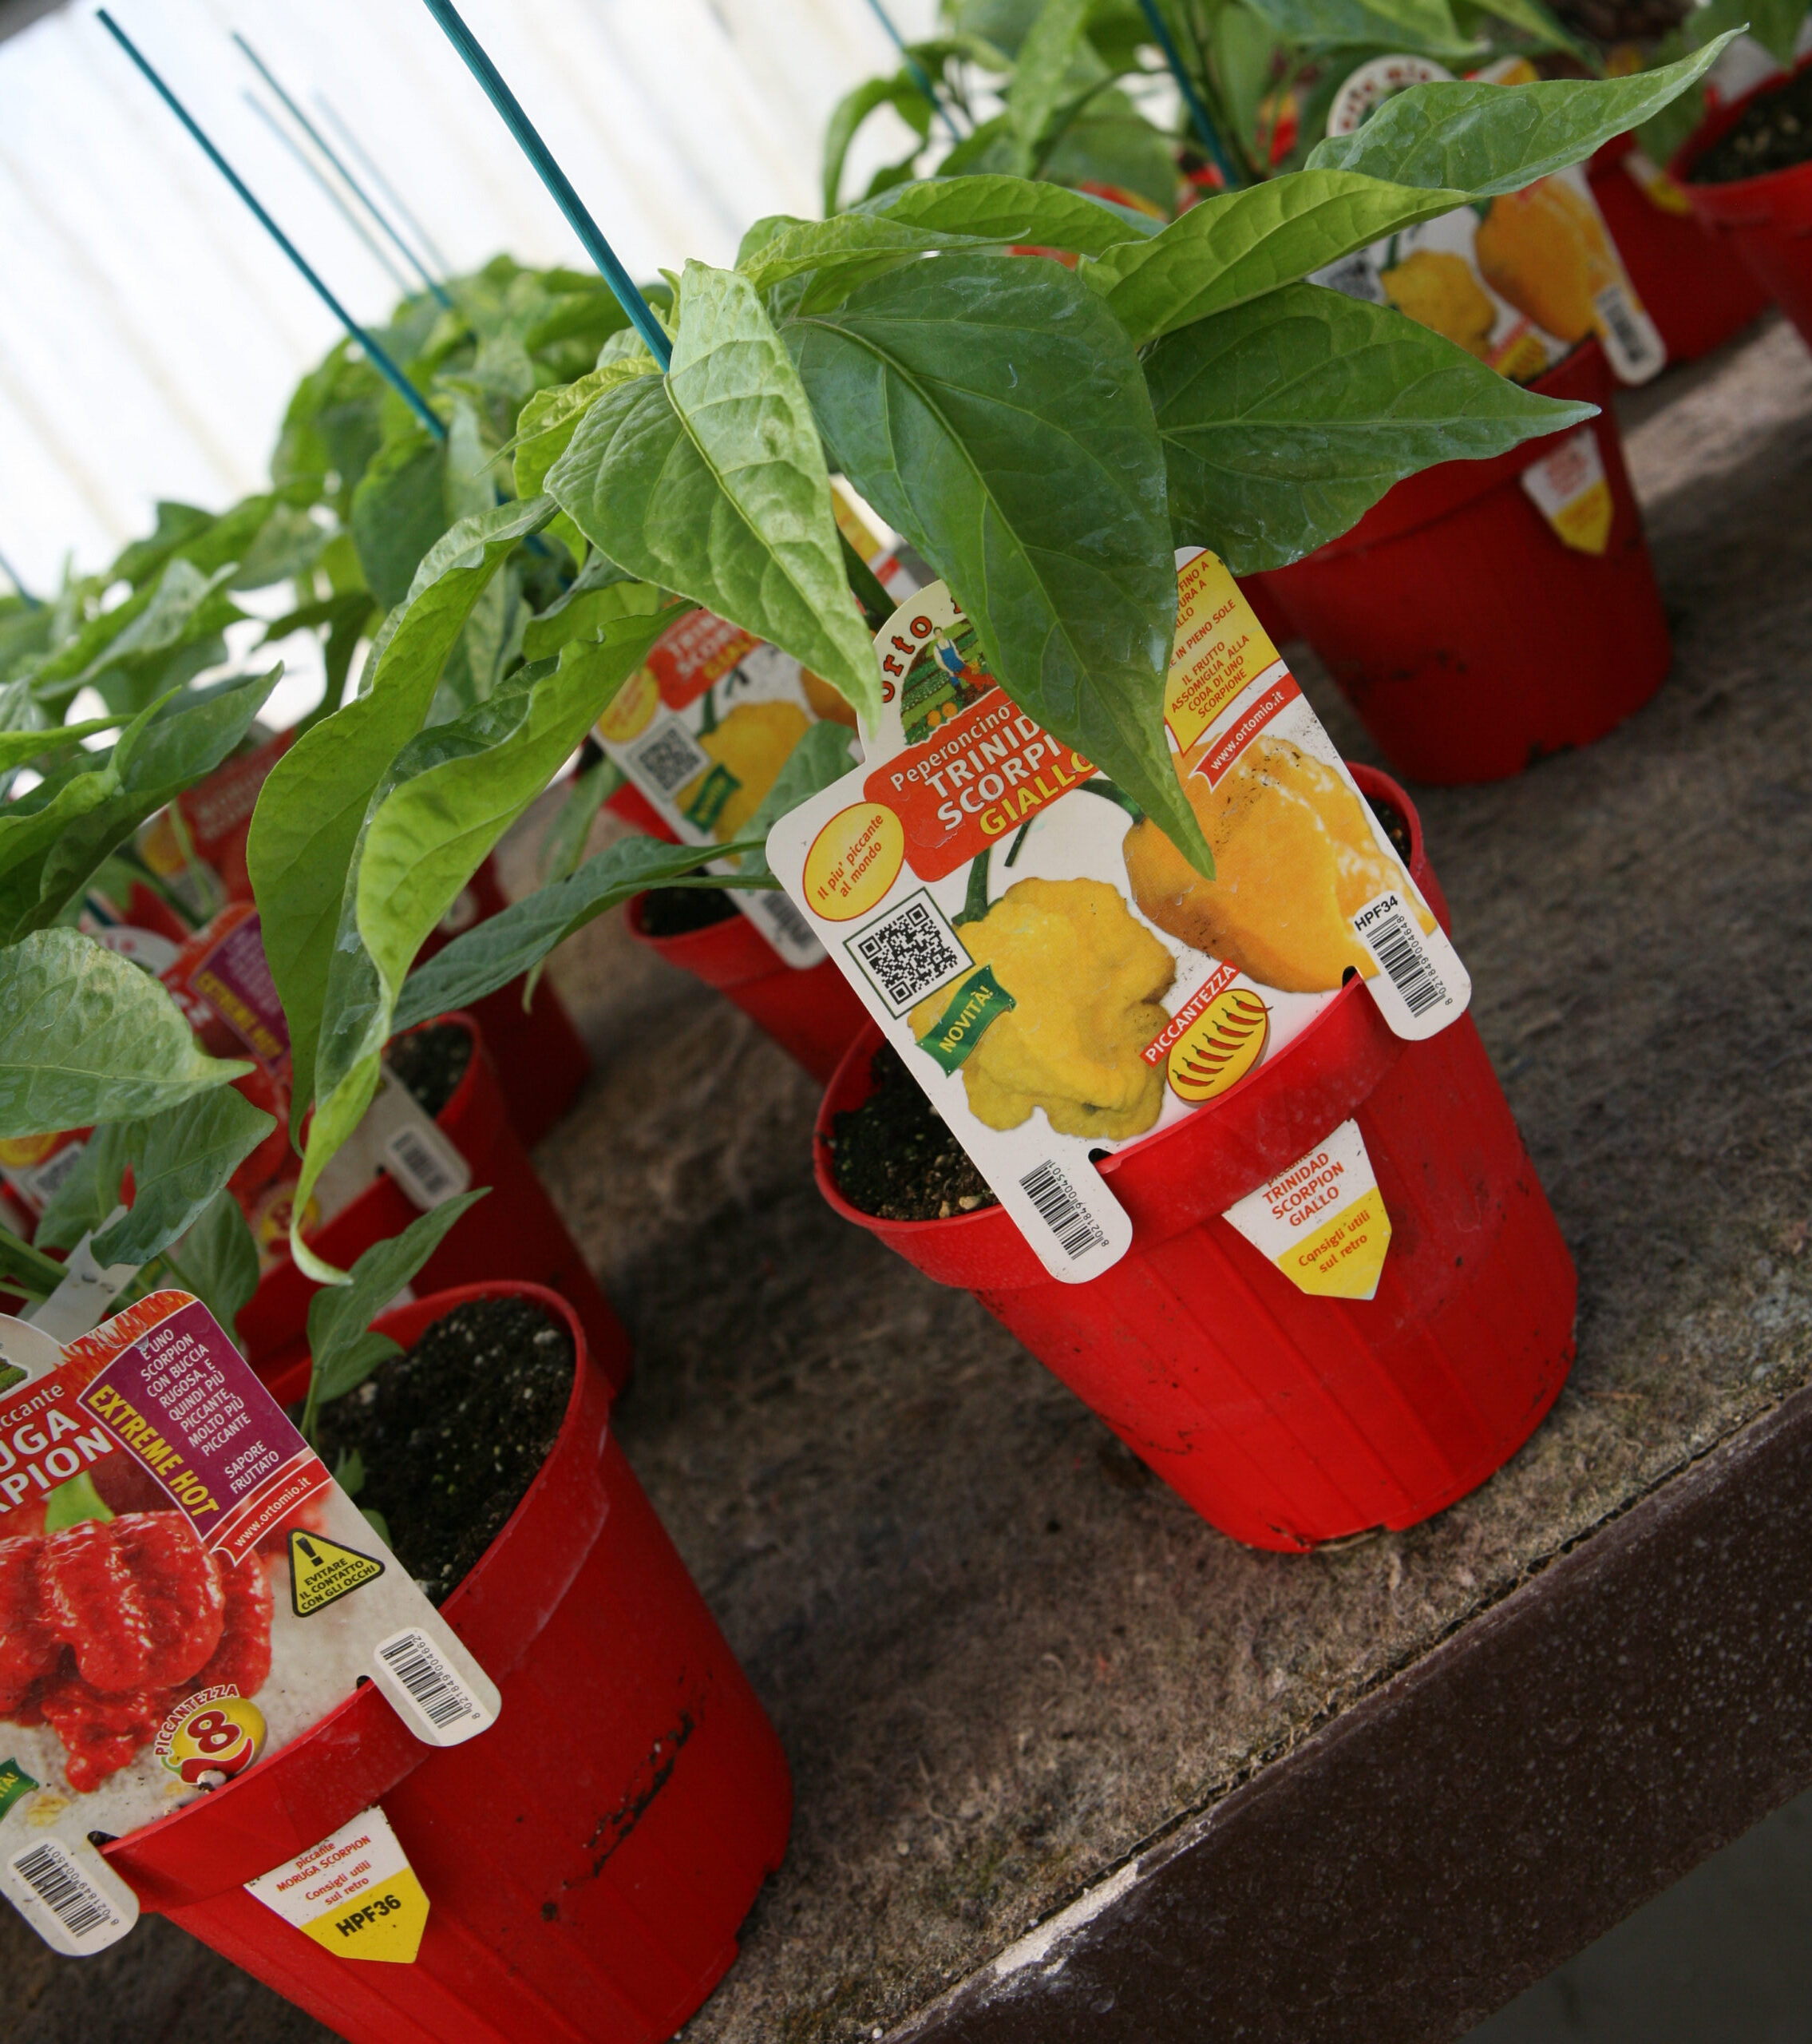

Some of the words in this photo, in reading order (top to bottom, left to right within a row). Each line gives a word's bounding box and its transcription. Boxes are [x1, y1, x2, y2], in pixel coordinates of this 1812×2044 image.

[1178, 568, 1200, 592] FINO
[1201, 560, 1209, 572] A
[1198, 579, 1207, 590] A
[1176, 645, 1187, 660] IN
[1186, 621, 1213, 649] PIENO
[1212, 599, 1236, 624] SOLE
[1171, 660, 1224, 713] ASSOMIGLIA
[1227, 635, 1250, 658] ALLA
[1181, 673, 1193, 686] IL
[1192, 641, 1225, 674] FRUTTO
[1188, 687, 1213, 712] CODA
[1213, 676, 1224, 689] DI
[1224, 655, 1244, 677] UNO
[1197, 668, 1248, 719] SCORPIONE
[890, 706, 1011, 792] Peperoncino
[1211, 691, 1284, 771] www.ortomio.it
[846, 814, 884, 866] piccante
[840, 881, 852, 897] al
[851, 842, 882, 884] mondo
[1354, 895, 1398, 931] HPF34
[939, 984, 994, 1054] NOVITÀ!
[1145, 965, 1237, 1062] PICCANTEZZA
[1262, 1152, 1329, 1205] TRINIDAD
[1272, 1162, 1344, 1220] SCORPION
[1289, 1186, 1339, 1226] GIALLO
[1298, 1228, 1345, 1266] Consigli
[1347, 1210, 1371, 1232] utili
[1319, 1254, 1339, 1274] sul
[1339, 1234, 1368, 1258] retro
[141, 1333, 194, 1381] SCORPION
[149, 1329, 174, 1353] UNO
[146, 1376, 171, 1397] CON
[170, 1343, 209, 1379] BUCCIA
[159, 1373, 208, 1408] RUGOSA,
[206, 1358, 216, 1371] E
[168, 1386, 206, 1421] QUINDI
[204, 1369, 225, 1392] PIÙ
[0, 1384, 65, 1432] ccante
[180, 1388, 236, 1432] PICCANTE,
[188, 1414, 224, 1447] MOLTO
[224, 1396, 245, 1418] PIÙ
[88, 1384, 184, 1476] EXTREME
[168, 1470, 220, 1516] HOT
[201, 1412, 251, 1456] PICCANTE
[0, 1426, 114, 1513] PION
[224, 1440, 267, 1479] SAPORE
[230, 1451, 279, 1495] FRUTTATO
[234, 1477, 311, 1547] www.ortomio.it
[299, 1591, 311, 1600] IL
[311, 1560, 364, 1593] CONTATTO
[301, 1594, 325, 1610] CON
[325, 1583, 343, 1597] GLI
[343, 1565, 376, 1586] OCCHI
[304, 1559, 348, 1586] EVITARE
[155, 1683, 239, 1757] PICCANTEZZA
[186, 1709, 242, 1753] 8
[276, 1865, 320, 1892] MORUGA
[320, 1835, 372, 1869] SCORPION
[295, 1841, 336, 1871] piccante
[305, 1872, 349, 1901] Consigli
[350, 1860, 372, 1877] utili
[325, 1891, 343, 1905] sul
[344, 1878, 370, 1895] retro
[334, 1895, 402, 1937] HPF36
